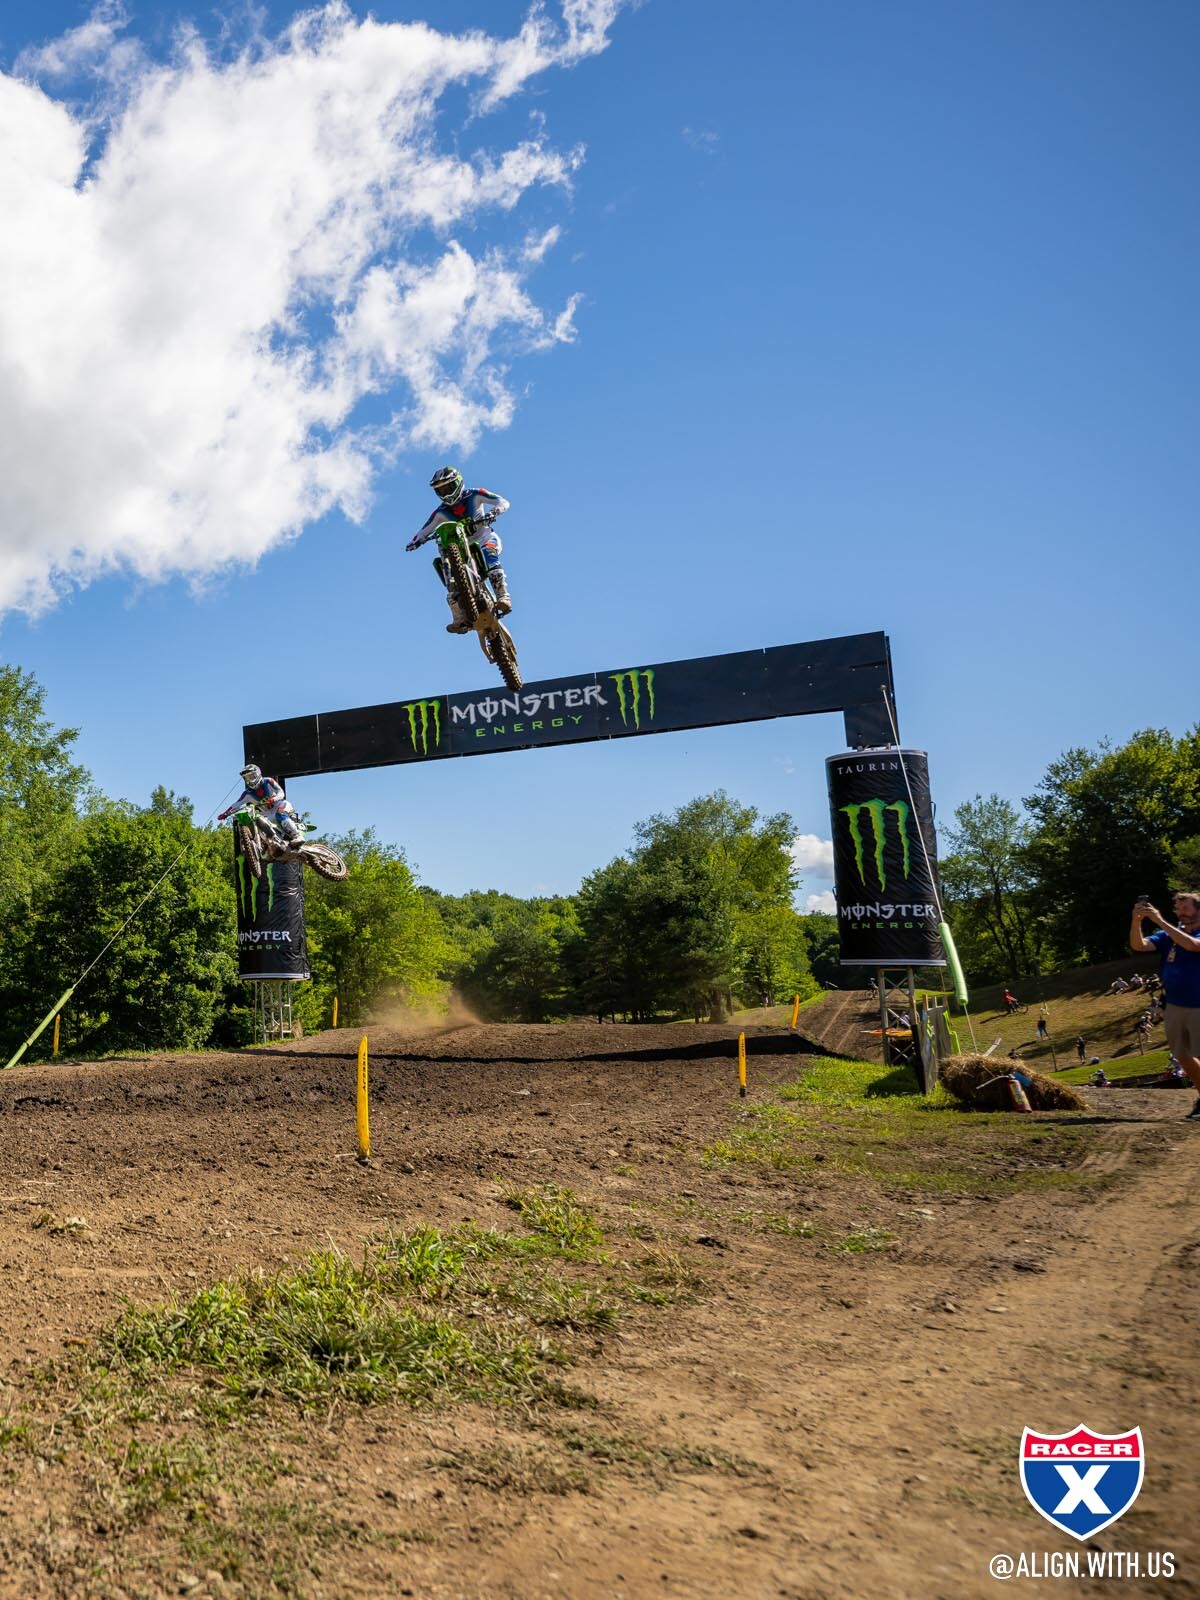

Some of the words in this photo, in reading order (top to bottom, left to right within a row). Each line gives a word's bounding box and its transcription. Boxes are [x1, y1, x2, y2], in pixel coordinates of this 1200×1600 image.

[451, 685, 608, 725] MONSTER
[476, 714, 583, 737] ENERGY
[838, 762, 909, 775] TAURINE
[841, 902, 937, 922] MONSTER
[238, 930, 292, 945] ONSTER
